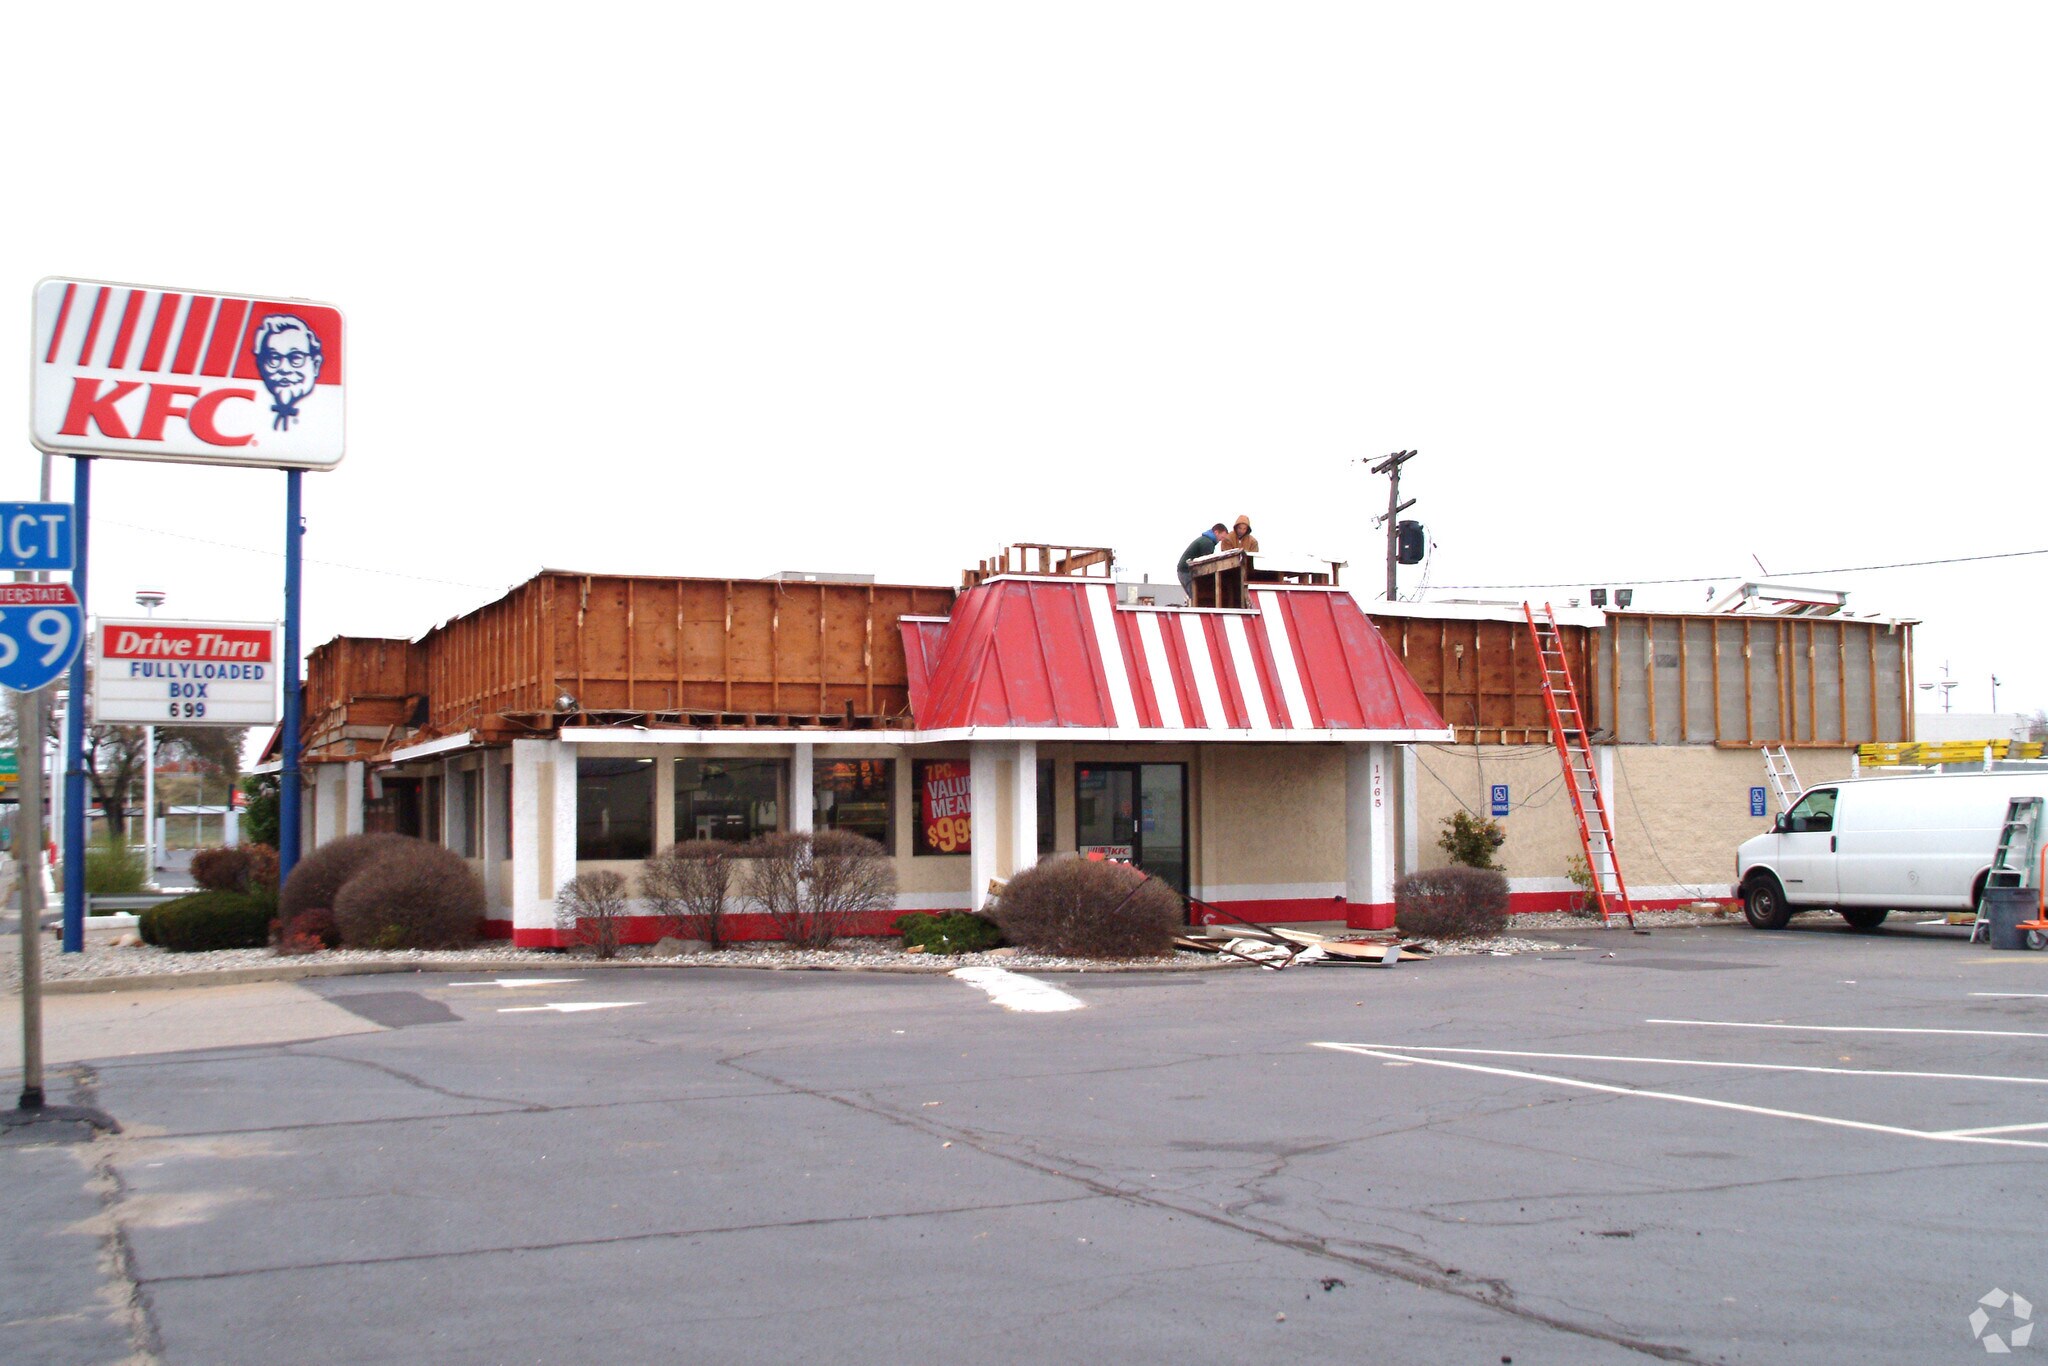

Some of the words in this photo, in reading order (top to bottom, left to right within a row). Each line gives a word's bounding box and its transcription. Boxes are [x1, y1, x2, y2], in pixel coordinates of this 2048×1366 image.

[57, 377, 257, 447] KFC
[115, 631, 192, 656] Drive
[196, 633, 260, 658] Thru
[169, 682, 208, 699] BOX
[928, 817, 971, 852] $99
